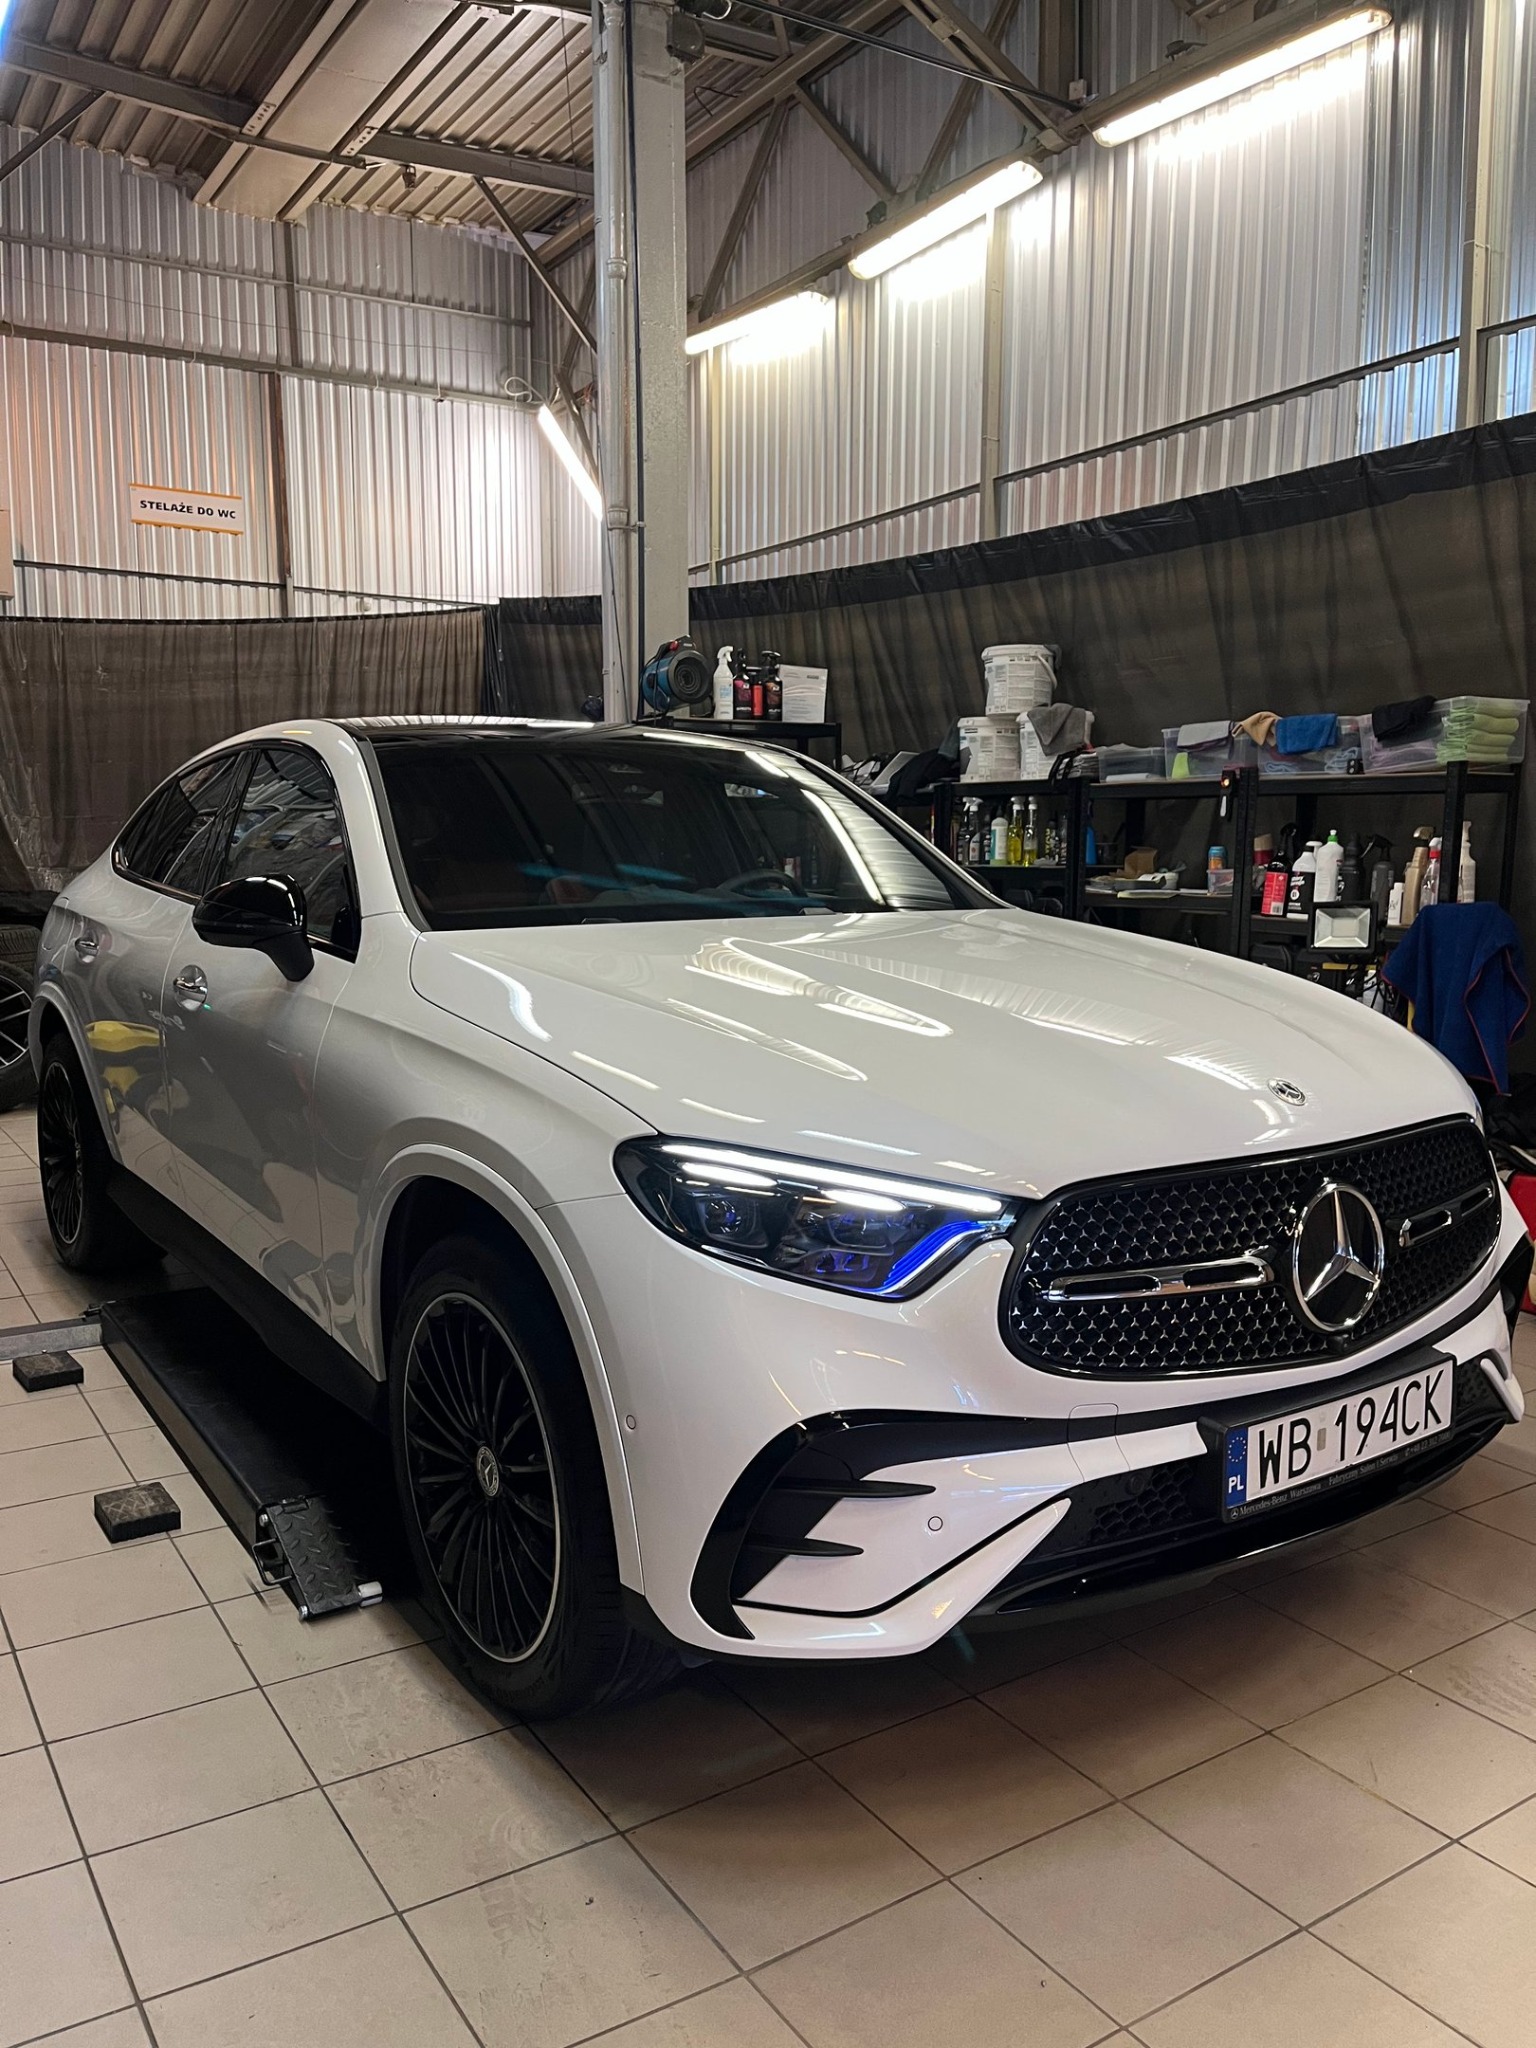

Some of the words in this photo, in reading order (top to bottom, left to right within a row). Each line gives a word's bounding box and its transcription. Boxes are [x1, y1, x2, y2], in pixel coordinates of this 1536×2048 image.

[140, 500, 194, 514] STELAŻE
[197, 506, 214, 516] DO
[218, 509, 236, 519] WC
[1259, 1417, 1311, 1488] WB
[1334, 1369, 1444, 1461] 194CK
[1228, 1475, 1244, 1493] PL
[1240, 1494, 1288, 1514] Mercedes-Benz
